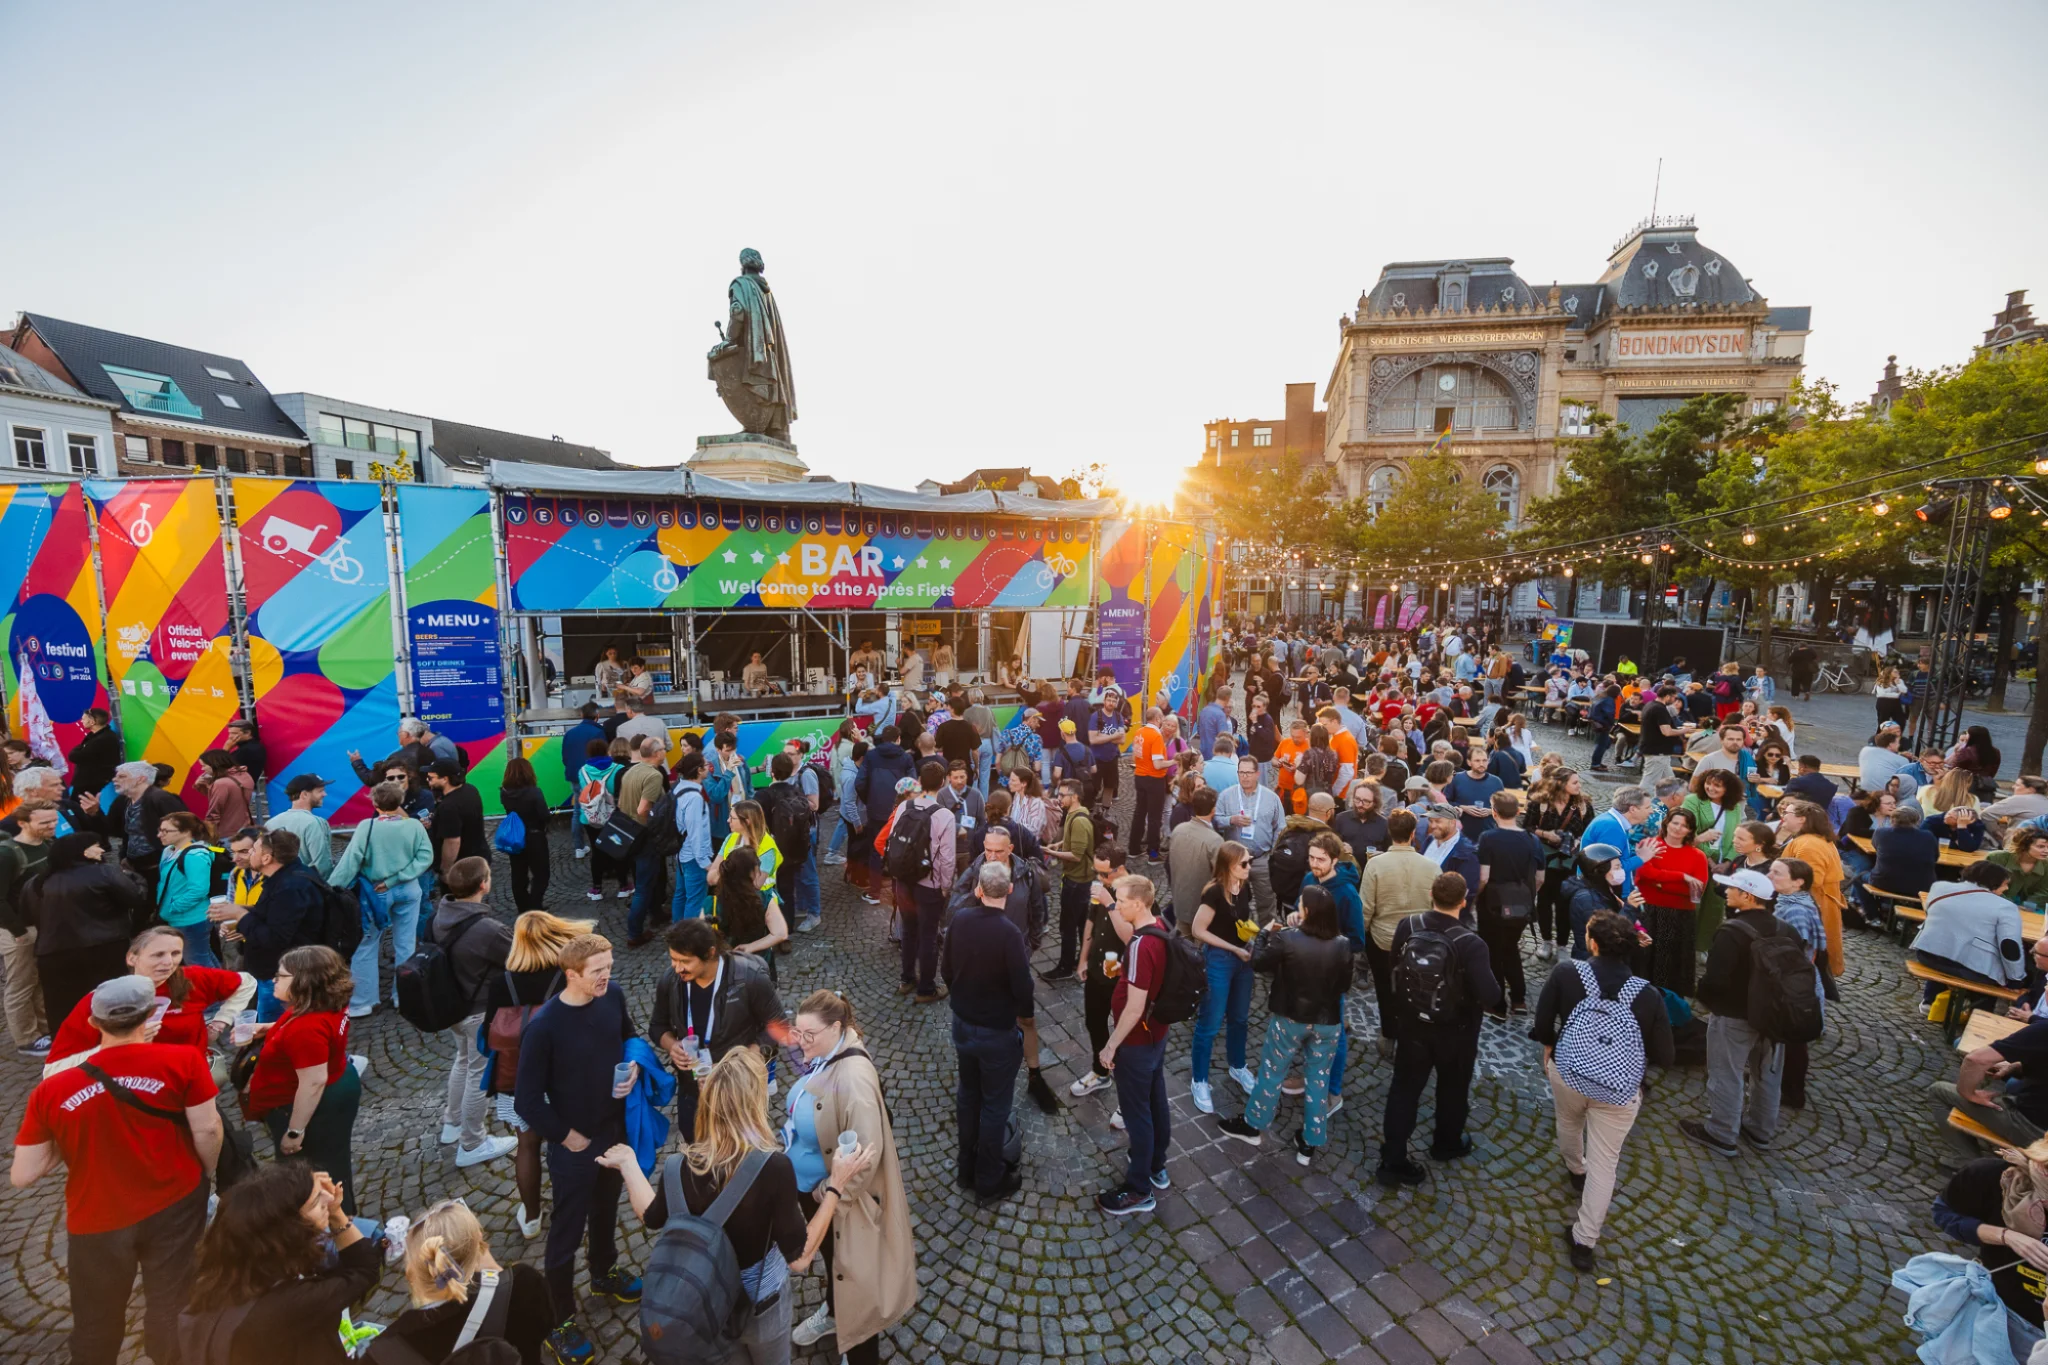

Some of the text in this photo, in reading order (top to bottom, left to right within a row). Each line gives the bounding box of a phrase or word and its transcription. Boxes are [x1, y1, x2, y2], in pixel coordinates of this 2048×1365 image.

[1370, 336, 1434, 346] SOCIALISTISCHE
[801, 543, 884, 577] BAR
[718, 579, 956, 600] Welcome to the Après Fiets
[1108, 608, 1135, 618] MENU
[427, 614, 480, 627] MENU
[168, 625, 203, 637] Official
[45, 641, 87, 658] festival
[117, 641, 151, 654] Velo-city
[169, 638, 214, 652] Velo-city
[171, 651, 199, 661] event
[421, 713, 452, 721] DEPOSIT
[60, 1081, 106, 1112] TUUPE
